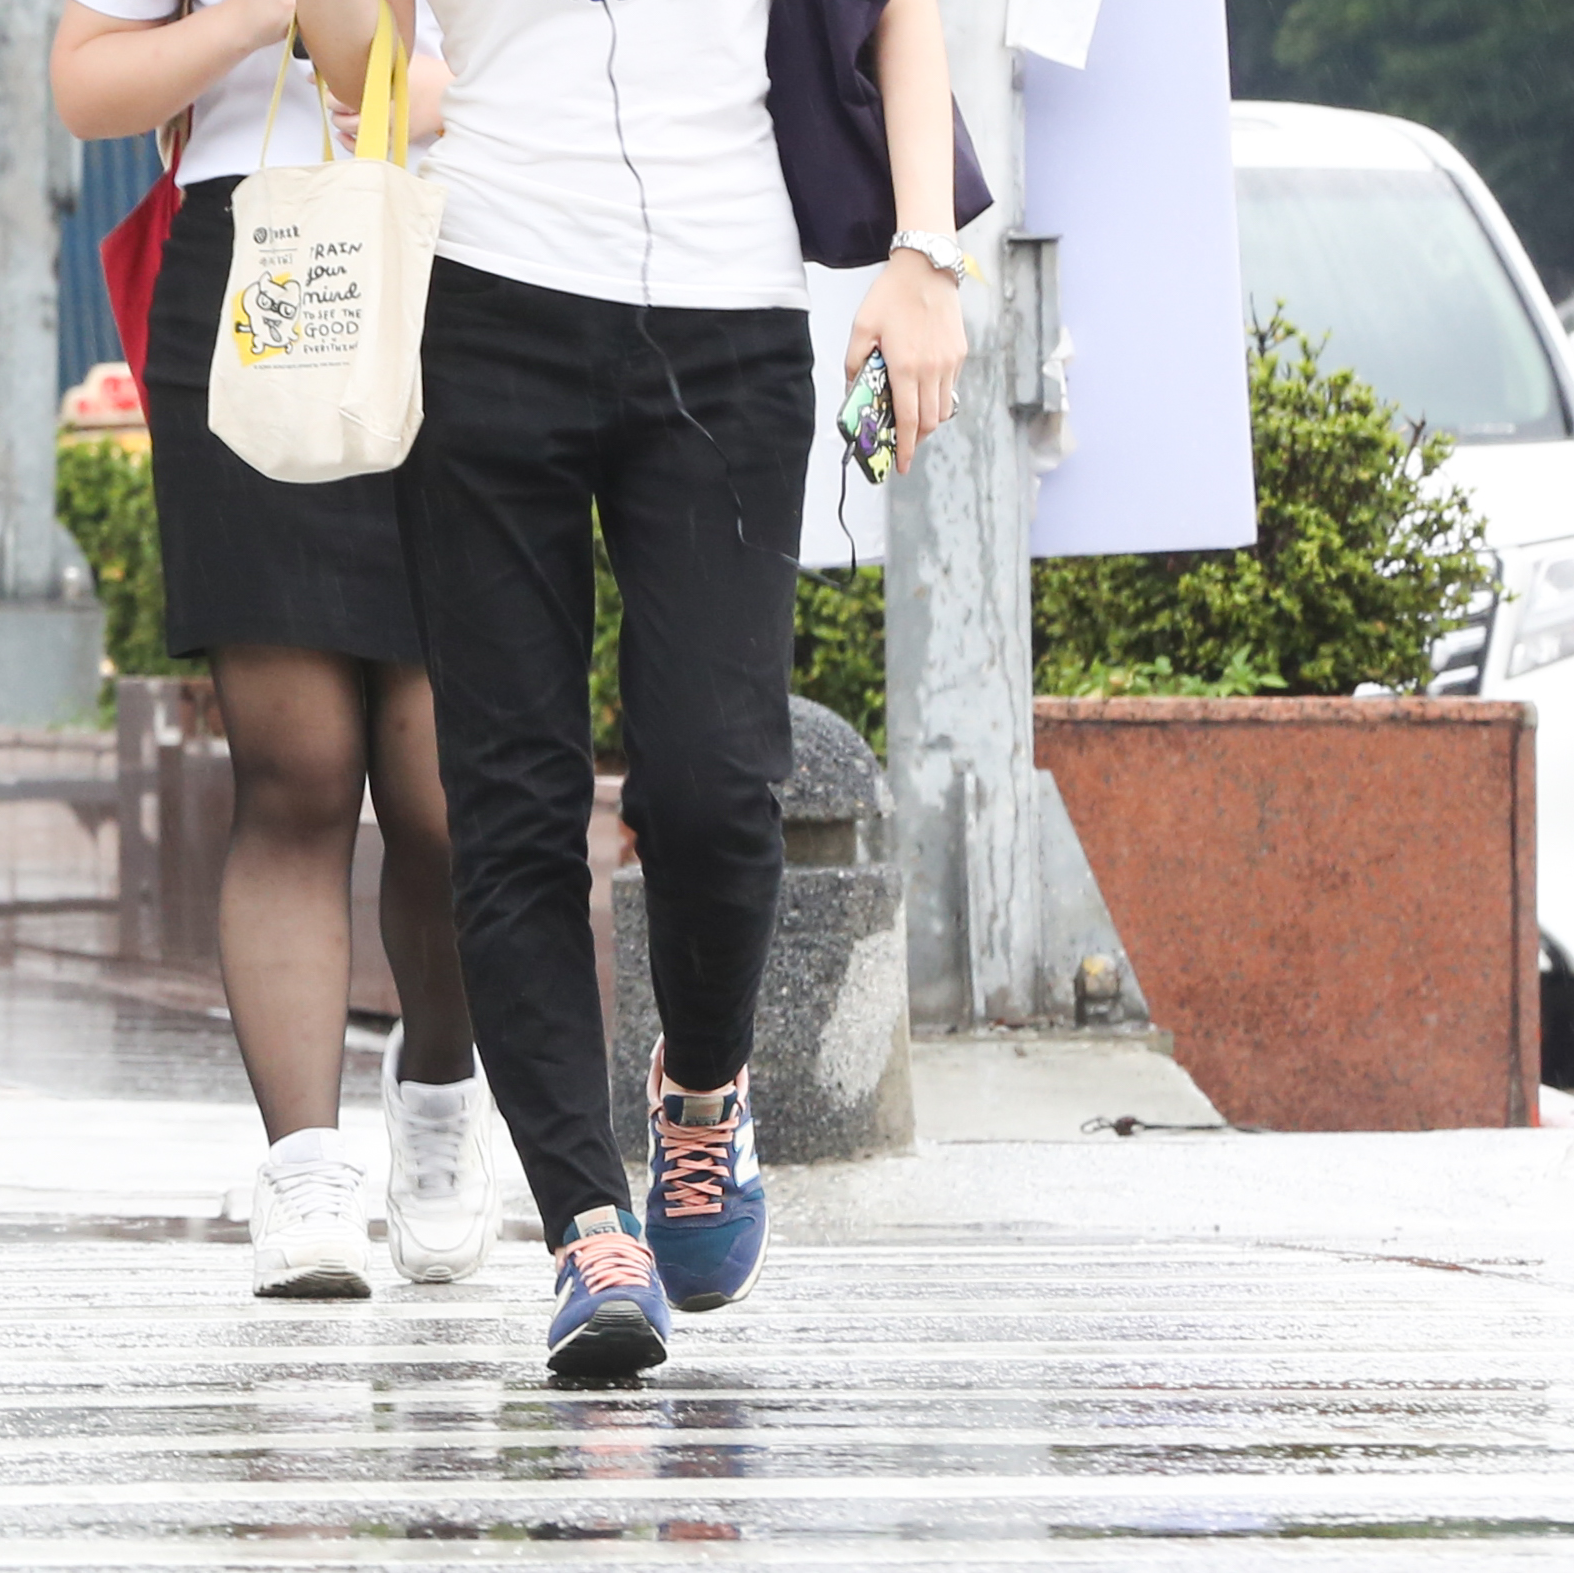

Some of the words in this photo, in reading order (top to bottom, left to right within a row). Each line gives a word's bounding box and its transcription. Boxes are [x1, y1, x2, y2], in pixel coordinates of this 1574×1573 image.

[302, 282, 362, 305] mind
[318, 309, 336, 321] SEE
[342, 309, 362, 319] THE
[304, 321, 360, 339] GOOD
